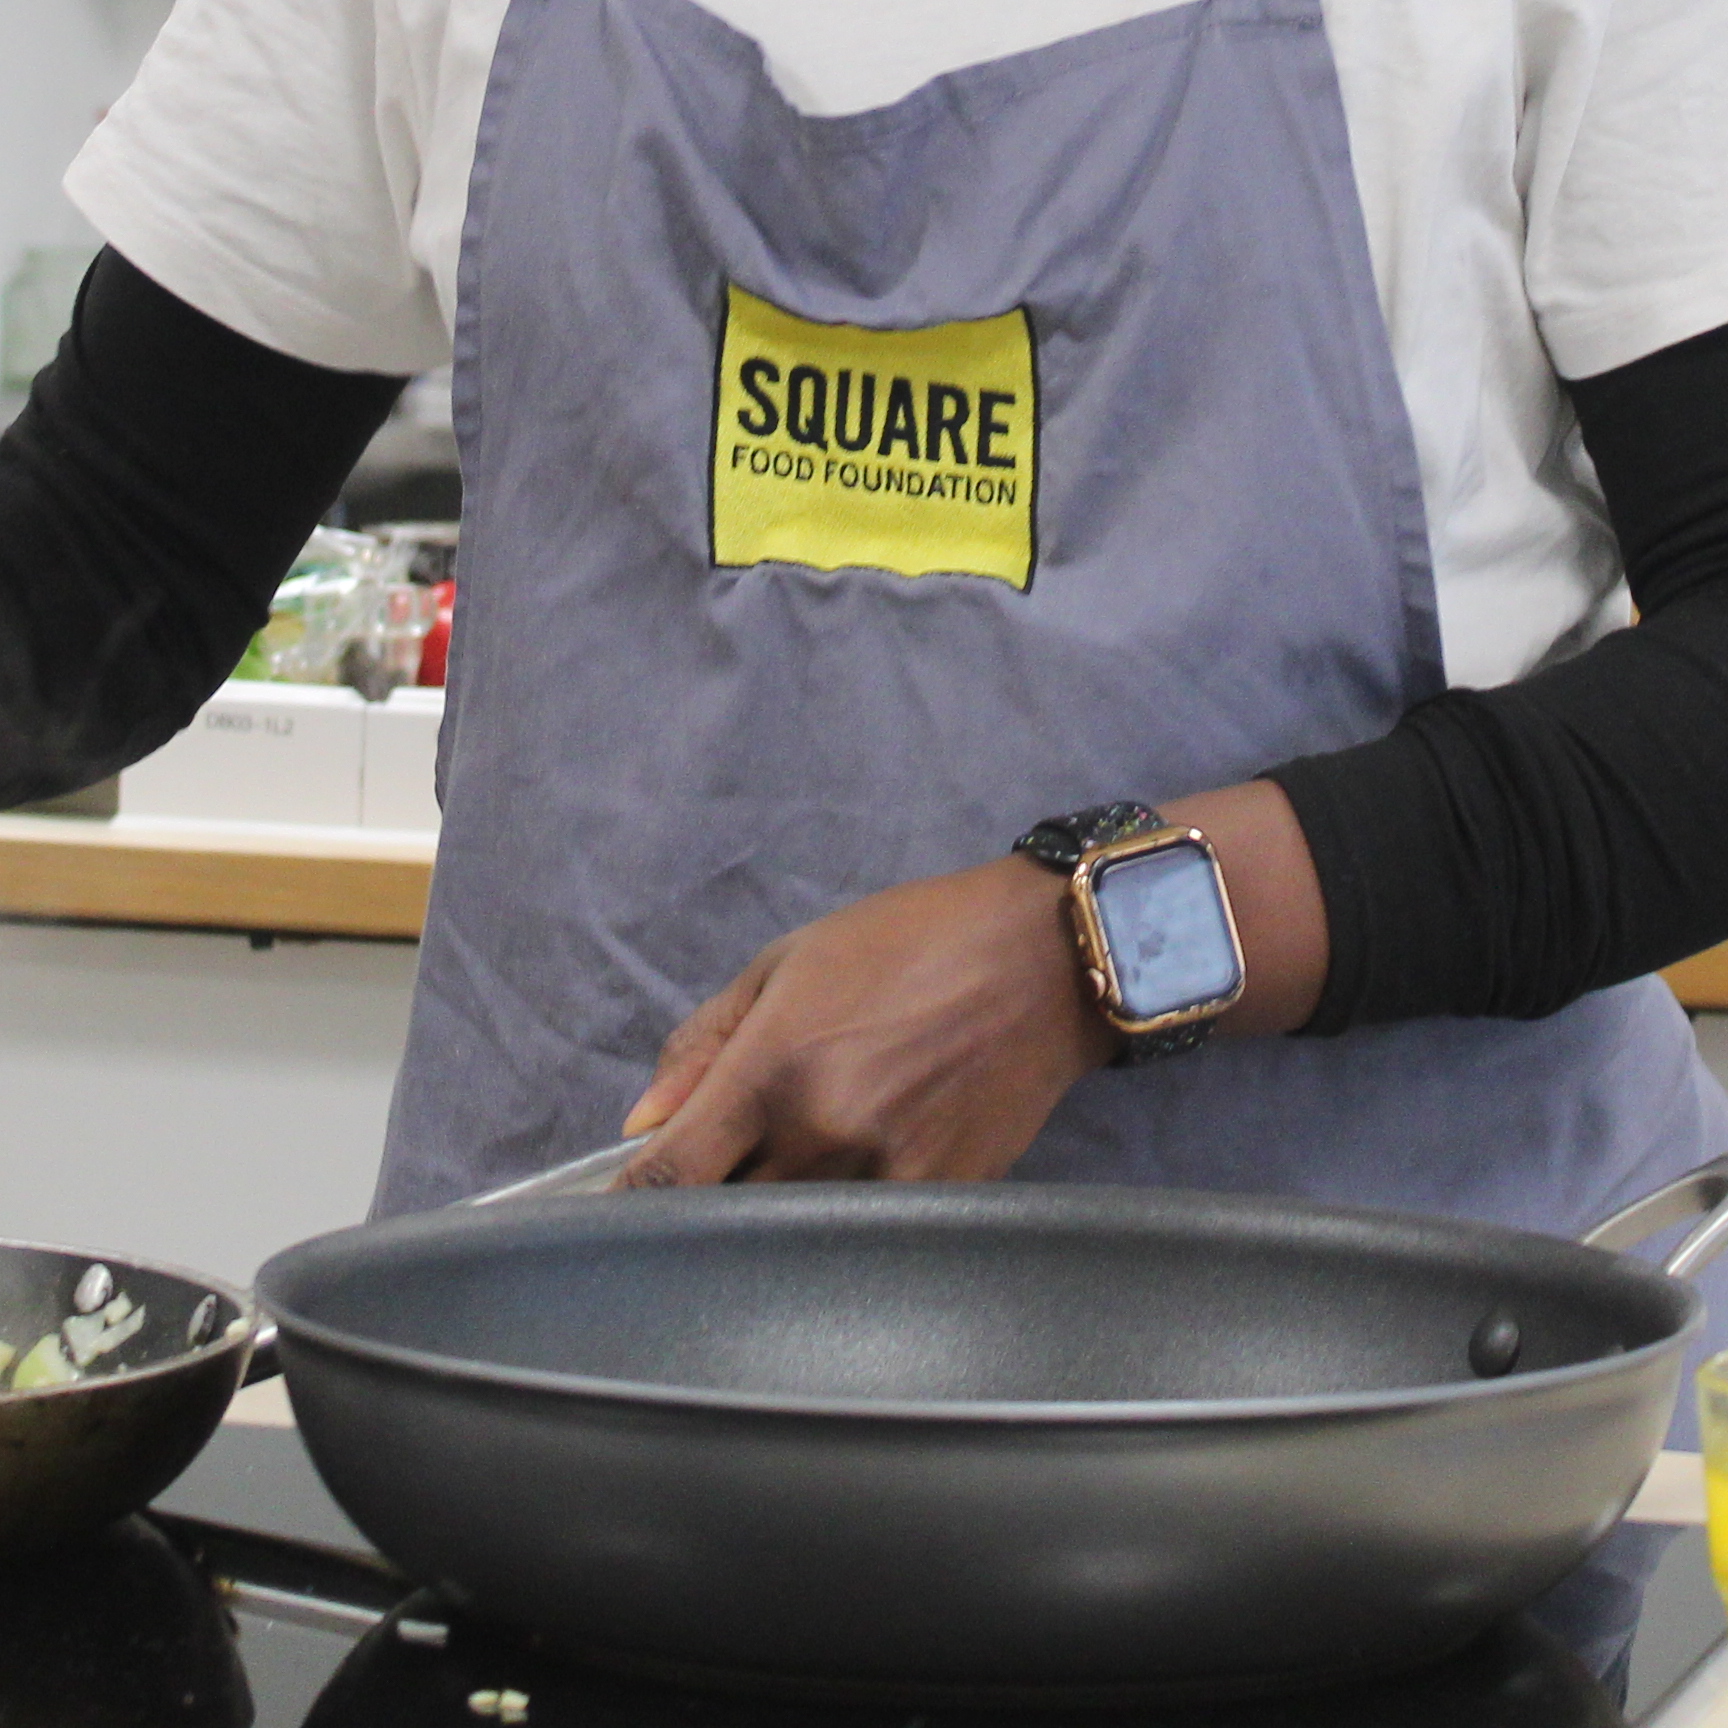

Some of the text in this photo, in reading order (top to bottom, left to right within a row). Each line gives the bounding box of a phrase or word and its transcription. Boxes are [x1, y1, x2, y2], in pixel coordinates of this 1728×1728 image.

[737, 357, 1016, 469] SQUARE
[731, 445, 1017, 506] FOOD FOUNDATION
